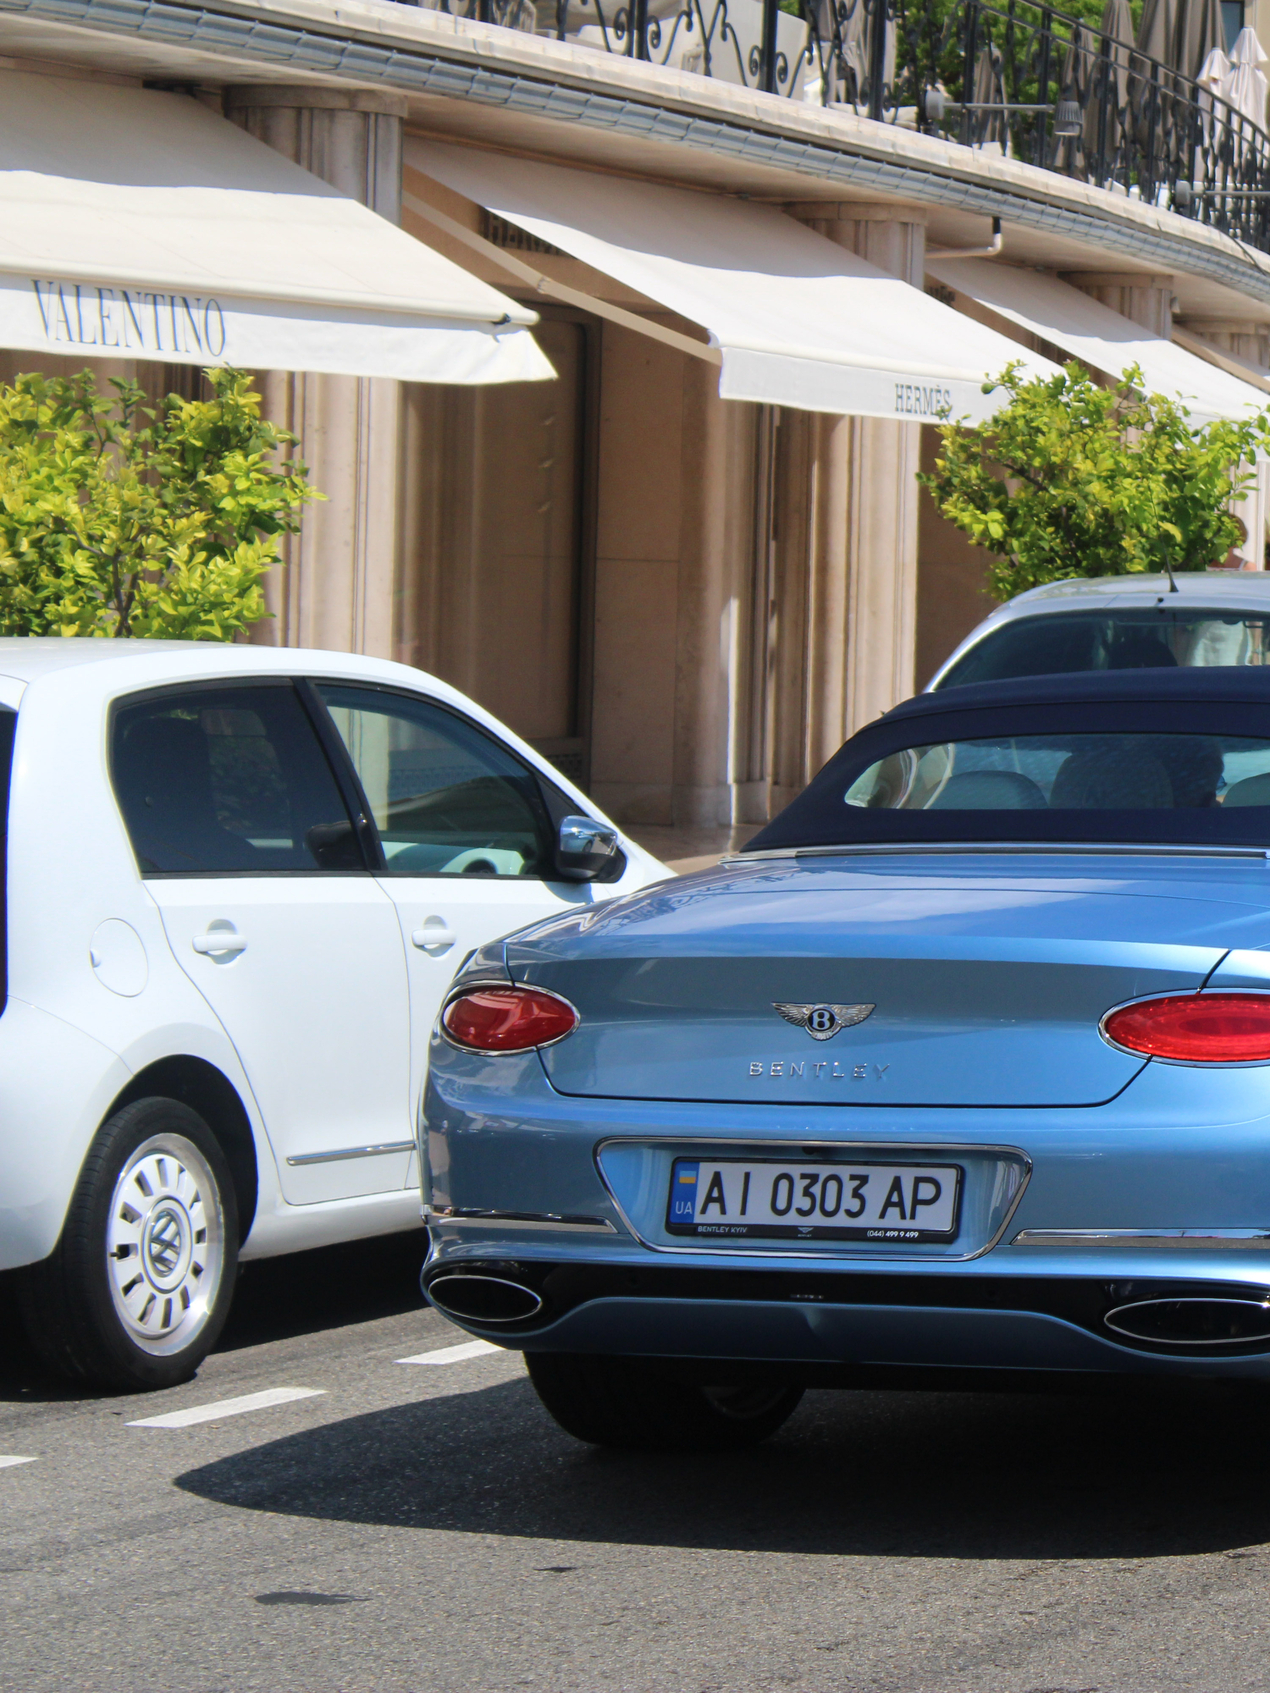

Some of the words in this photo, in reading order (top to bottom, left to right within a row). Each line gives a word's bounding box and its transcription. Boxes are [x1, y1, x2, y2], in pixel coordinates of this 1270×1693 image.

[31, 279, 226, 357] VALENTINO
[894, 383, 951, 418] HERMÈS
[750, 1061, 890, 1078] BENTLEY
[675, 1201, 693, 1215] UA
[700, 1171, 751, 1216] AI
[771, 1172, 869, 1219] 0303
[878, 1175, 942, 1220] AP
